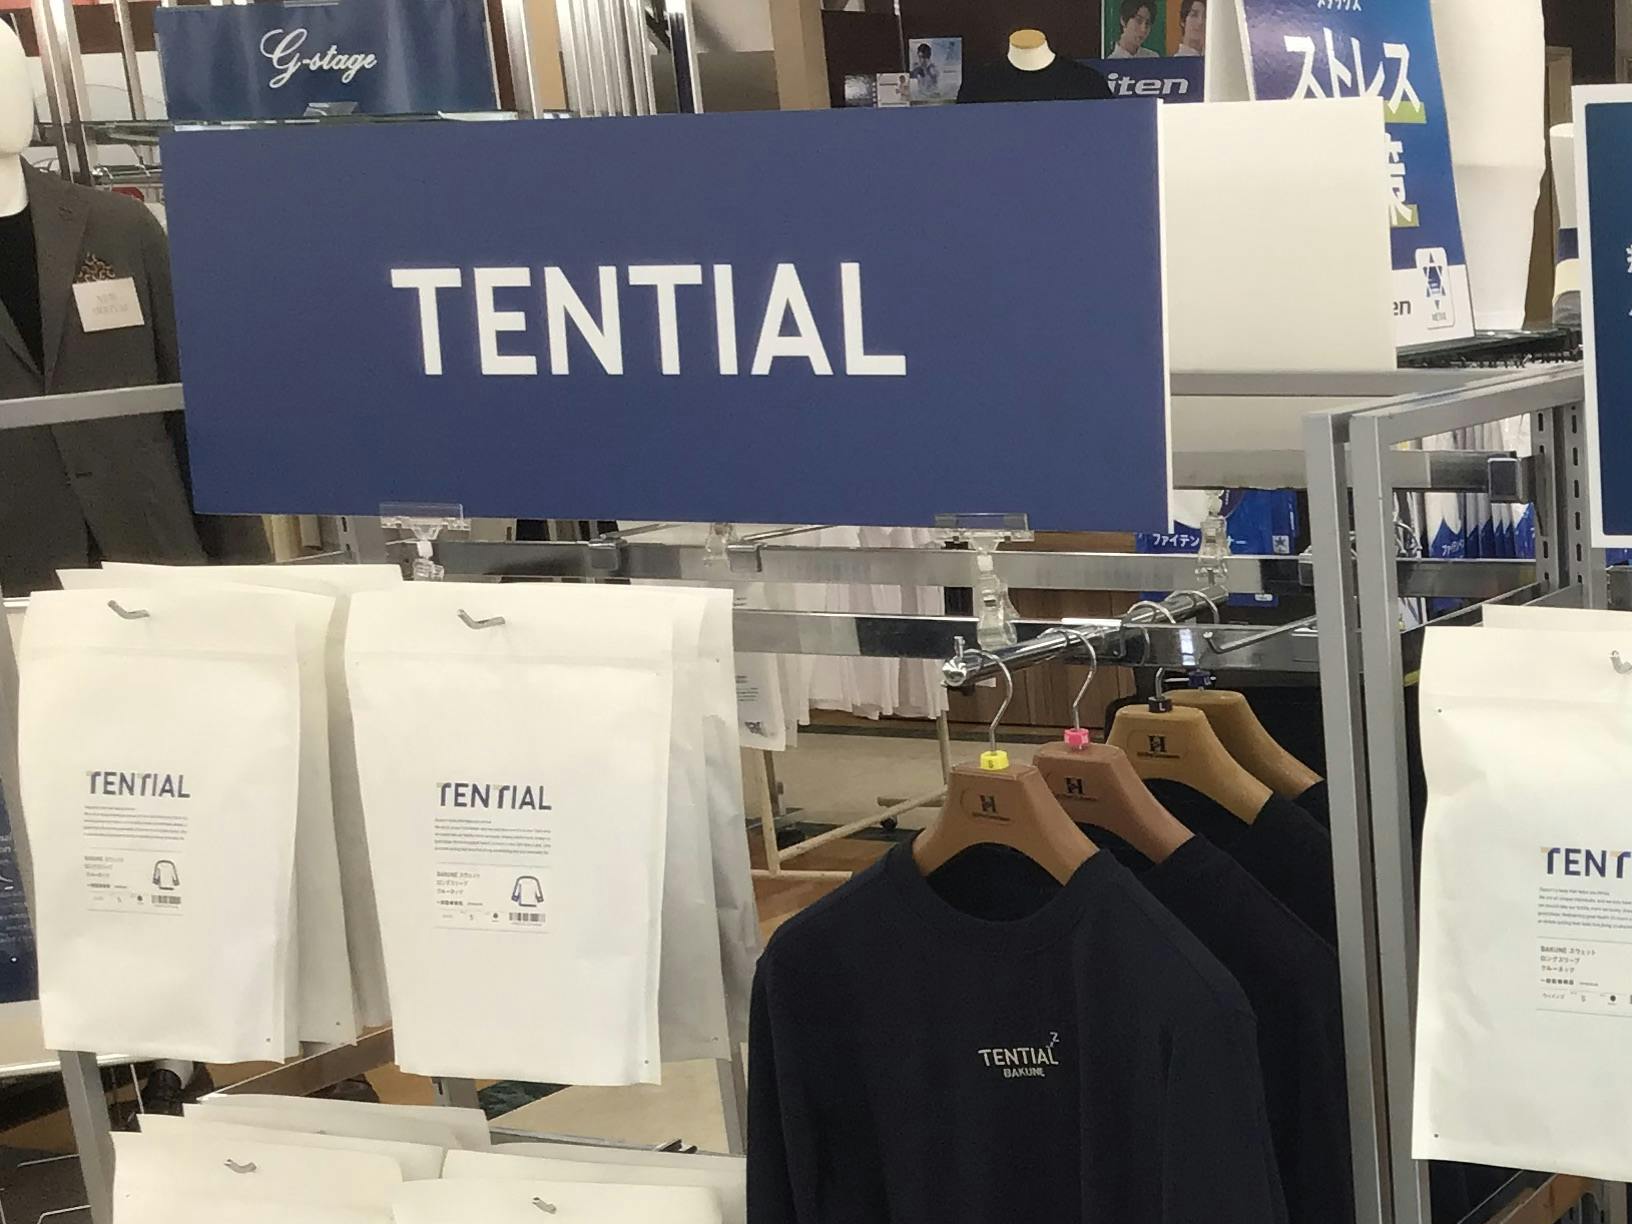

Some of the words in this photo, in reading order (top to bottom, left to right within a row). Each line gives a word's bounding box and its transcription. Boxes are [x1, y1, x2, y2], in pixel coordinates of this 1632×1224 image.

[260, 28, 377, 88] G-stage
[390, 262, 908, 378] TENTIAL
[86, 771, 191, 799] TENTIAL
[436, 782, 553, 811] TENTIAL
[977, 1047, 1059, 1067] TENTIAL
